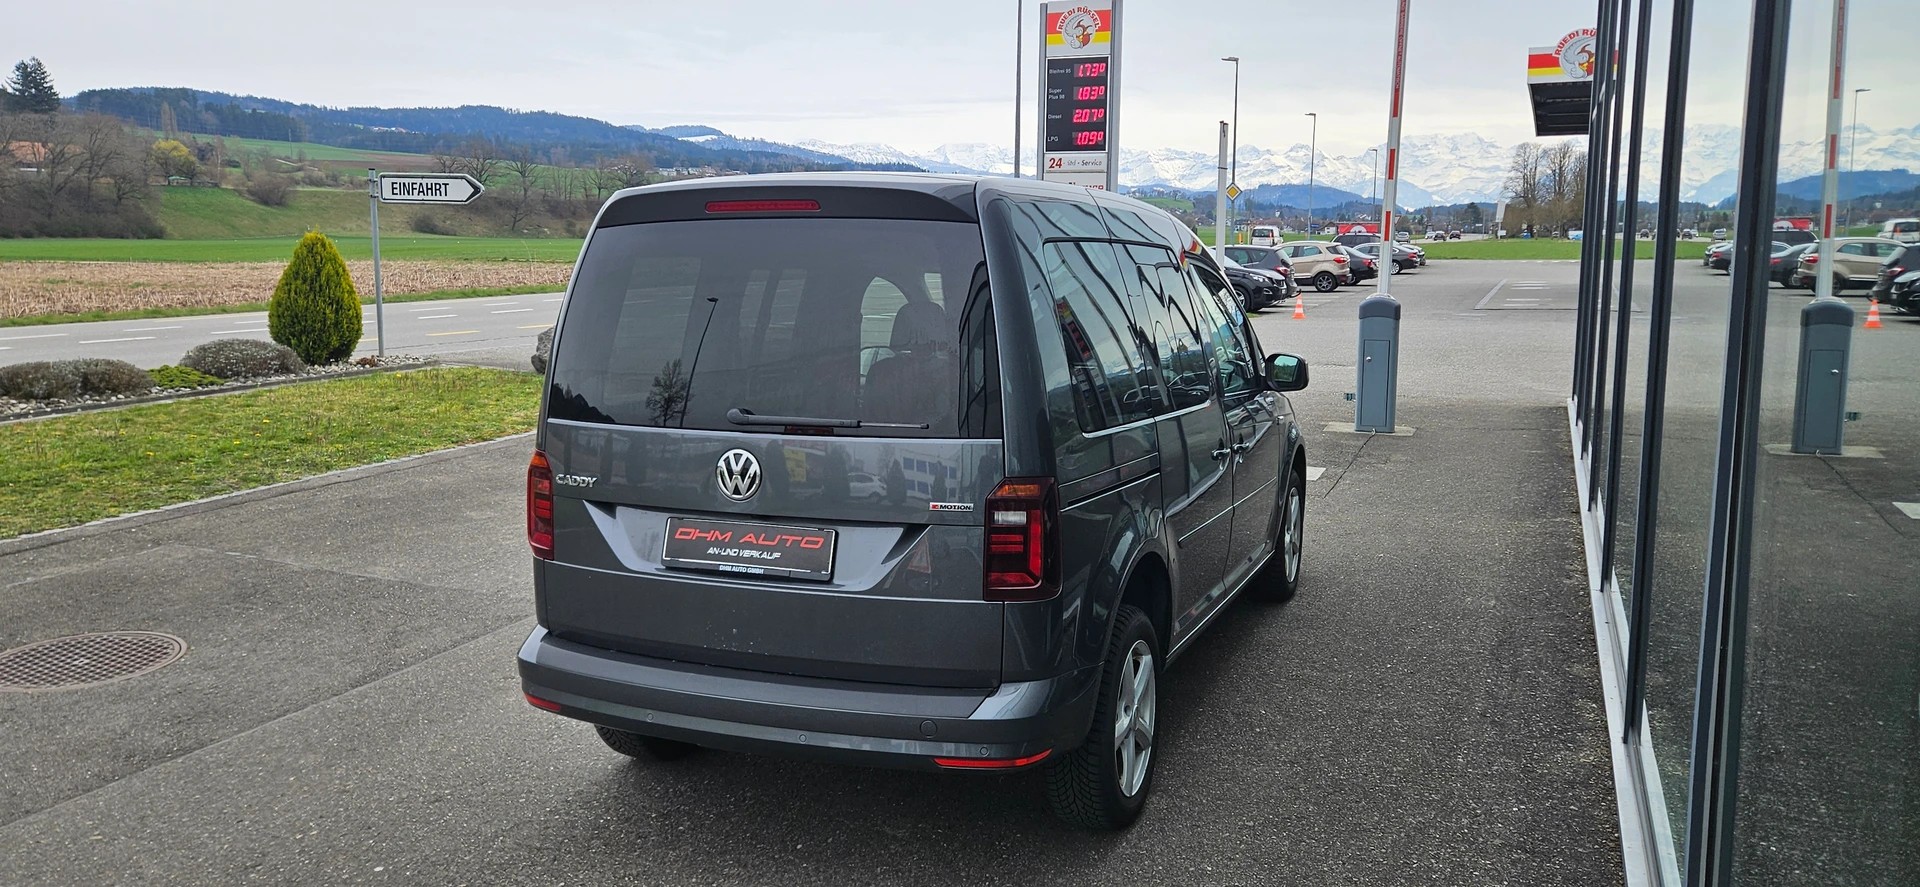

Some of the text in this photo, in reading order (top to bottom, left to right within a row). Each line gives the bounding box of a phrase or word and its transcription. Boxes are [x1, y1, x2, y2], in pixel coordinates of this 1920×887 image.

[1057, 6, 1101, 30] RUEDI RÜSSEL
[1553, 30, 1580, 56] RUEDI
[1048, 157, 1063, 169] 24
[391, 182, 450, 197] EINFAHRT
[555, 473, 598, 488] CADDY
[738, 532, 825, 549] AUTO
[739, 549, 782, 560] VERKAUF
[732, 565, 747, 573] AUTO
